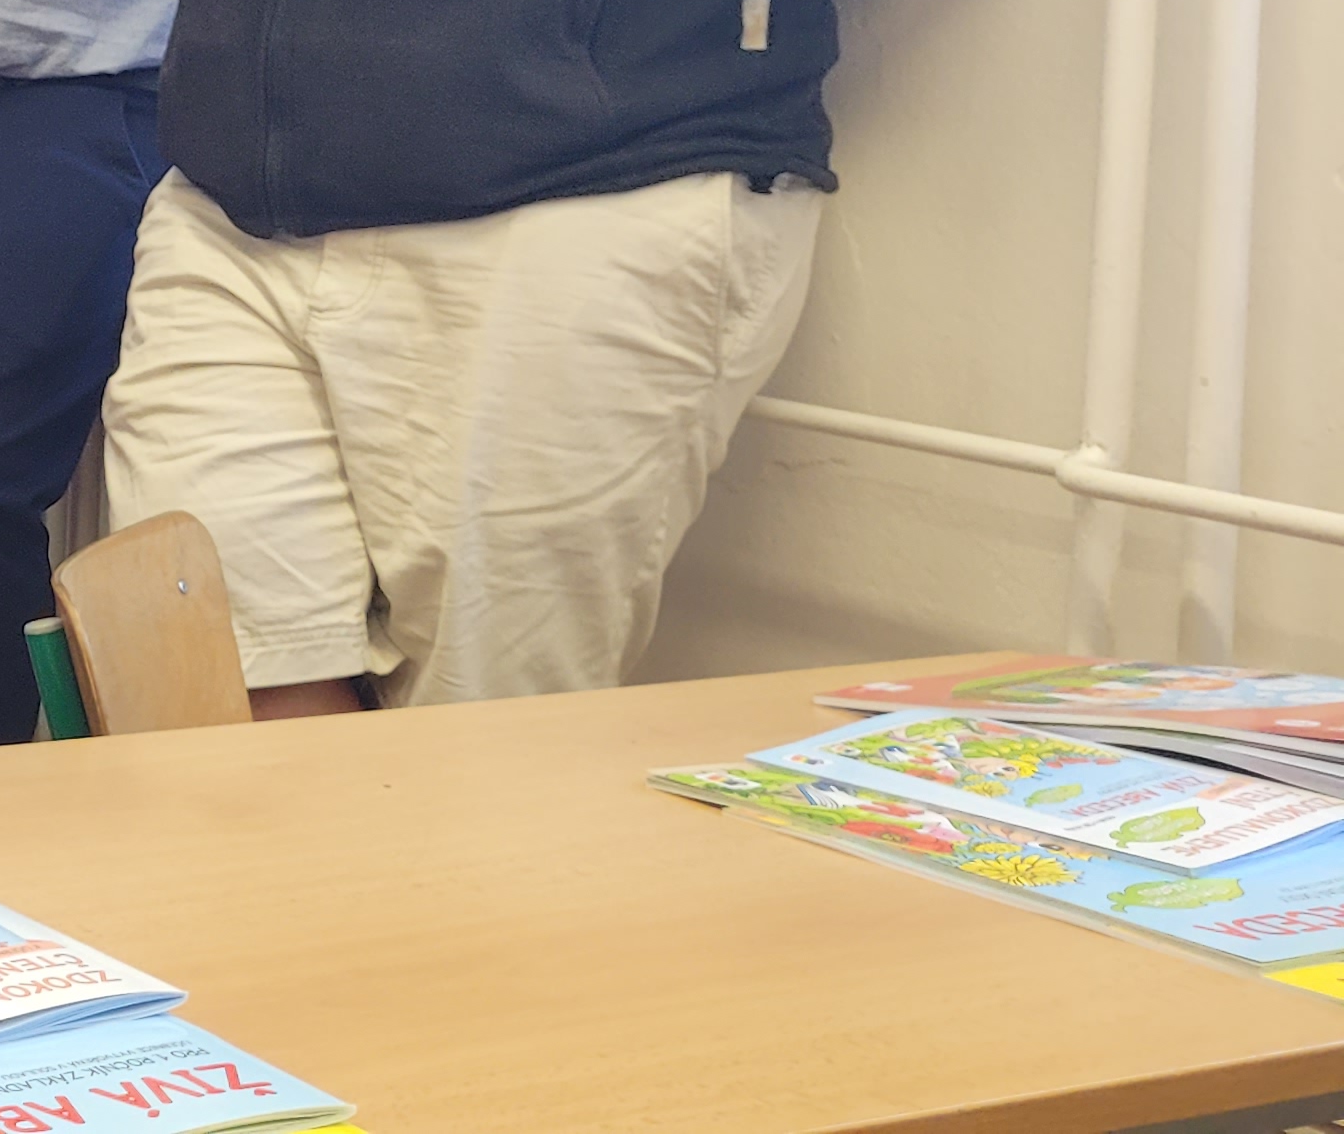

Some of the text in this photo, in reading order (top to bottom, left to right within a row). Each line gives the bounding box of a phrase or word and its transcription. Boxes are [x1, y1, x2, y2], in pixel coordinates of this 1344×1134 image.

[170, 1047, 211, 1058] PRO
[83, 1056, 156, 1077] ROČNÍK
[89, 1063, 277, 1118] ŽIVÁ
